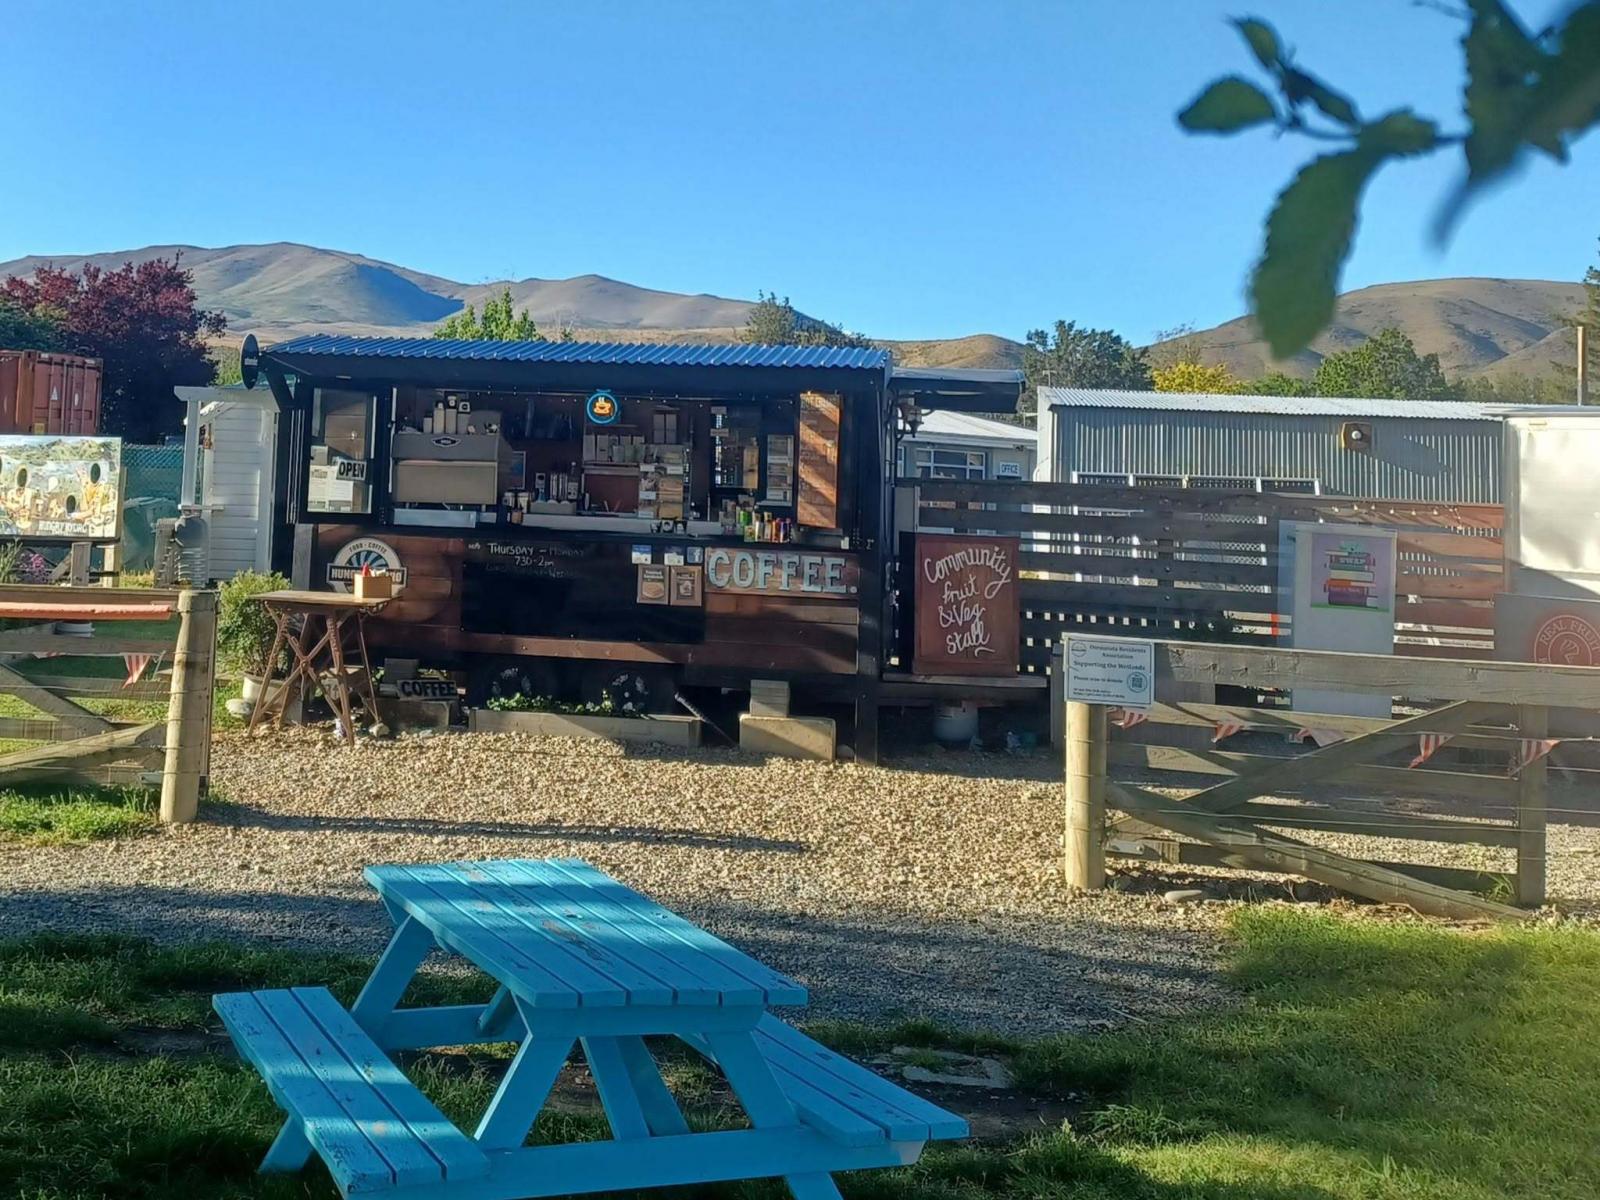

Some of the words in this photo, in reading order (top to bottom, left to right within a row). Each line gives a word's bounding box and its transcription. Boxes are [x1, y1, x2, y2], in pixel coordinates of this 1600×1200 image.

[338, 462, 365, 478] OPEN
[1001, 463, 1018, 474] OFFICE
[1540, 620, 1567, 646] REAL
[1073, 661, 1106, 669] Supporting
[401, 681, 456, 697] COFFEE
